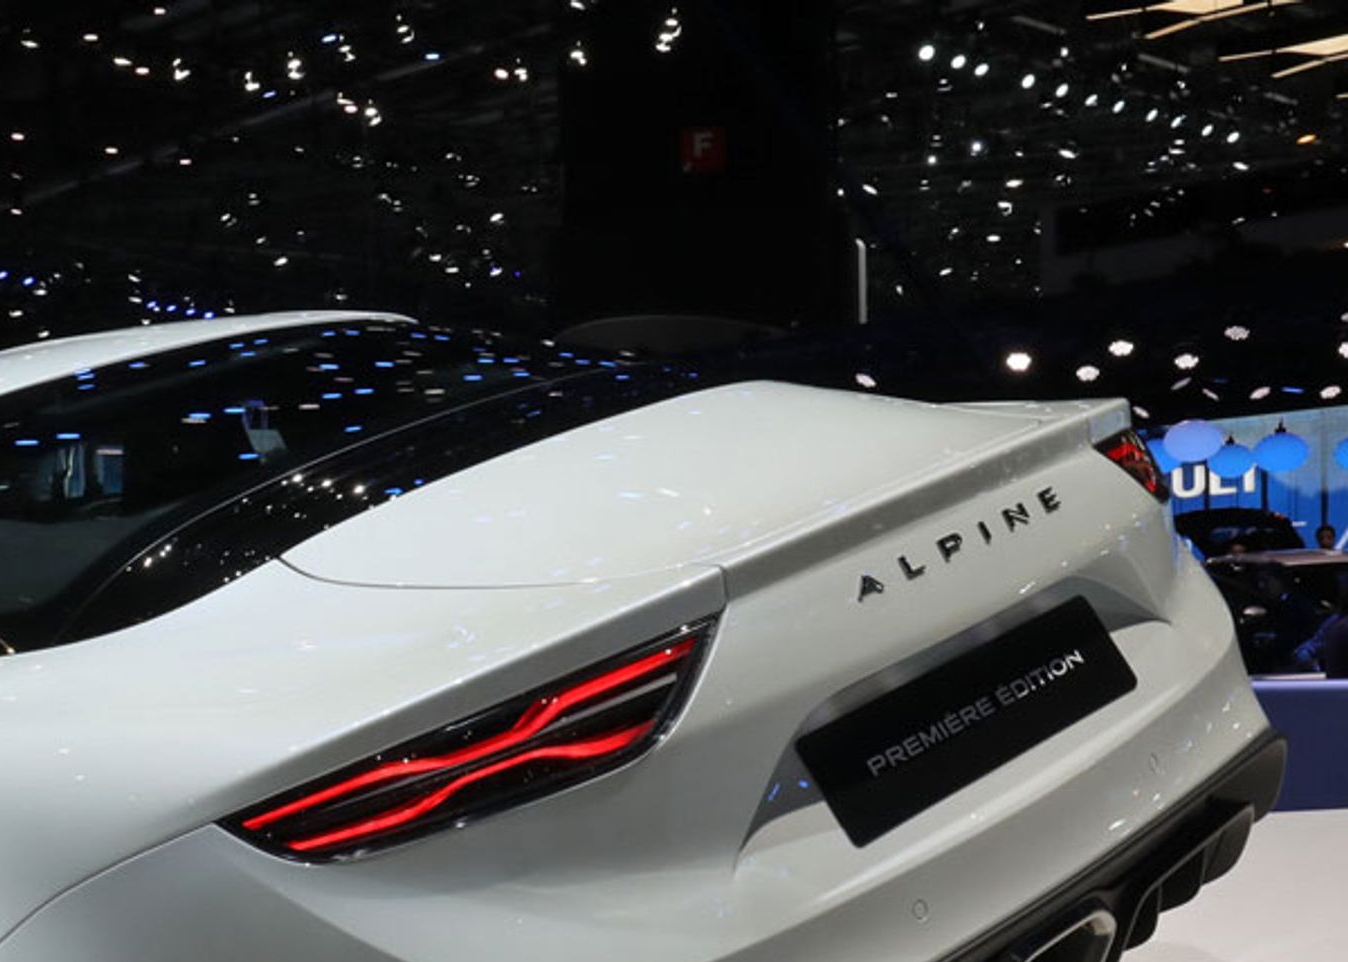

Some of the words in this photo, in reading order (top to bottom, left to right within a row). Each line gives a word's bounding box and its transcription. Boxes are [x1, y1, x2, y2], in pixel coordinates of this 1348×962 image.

[693, 131, 714, 158] F
[858, 486, 1061, 602] ALPINE
[866, 697, 995, 776] PREMIÈRE
[995, 649, 1084, 706] ÉDITION
